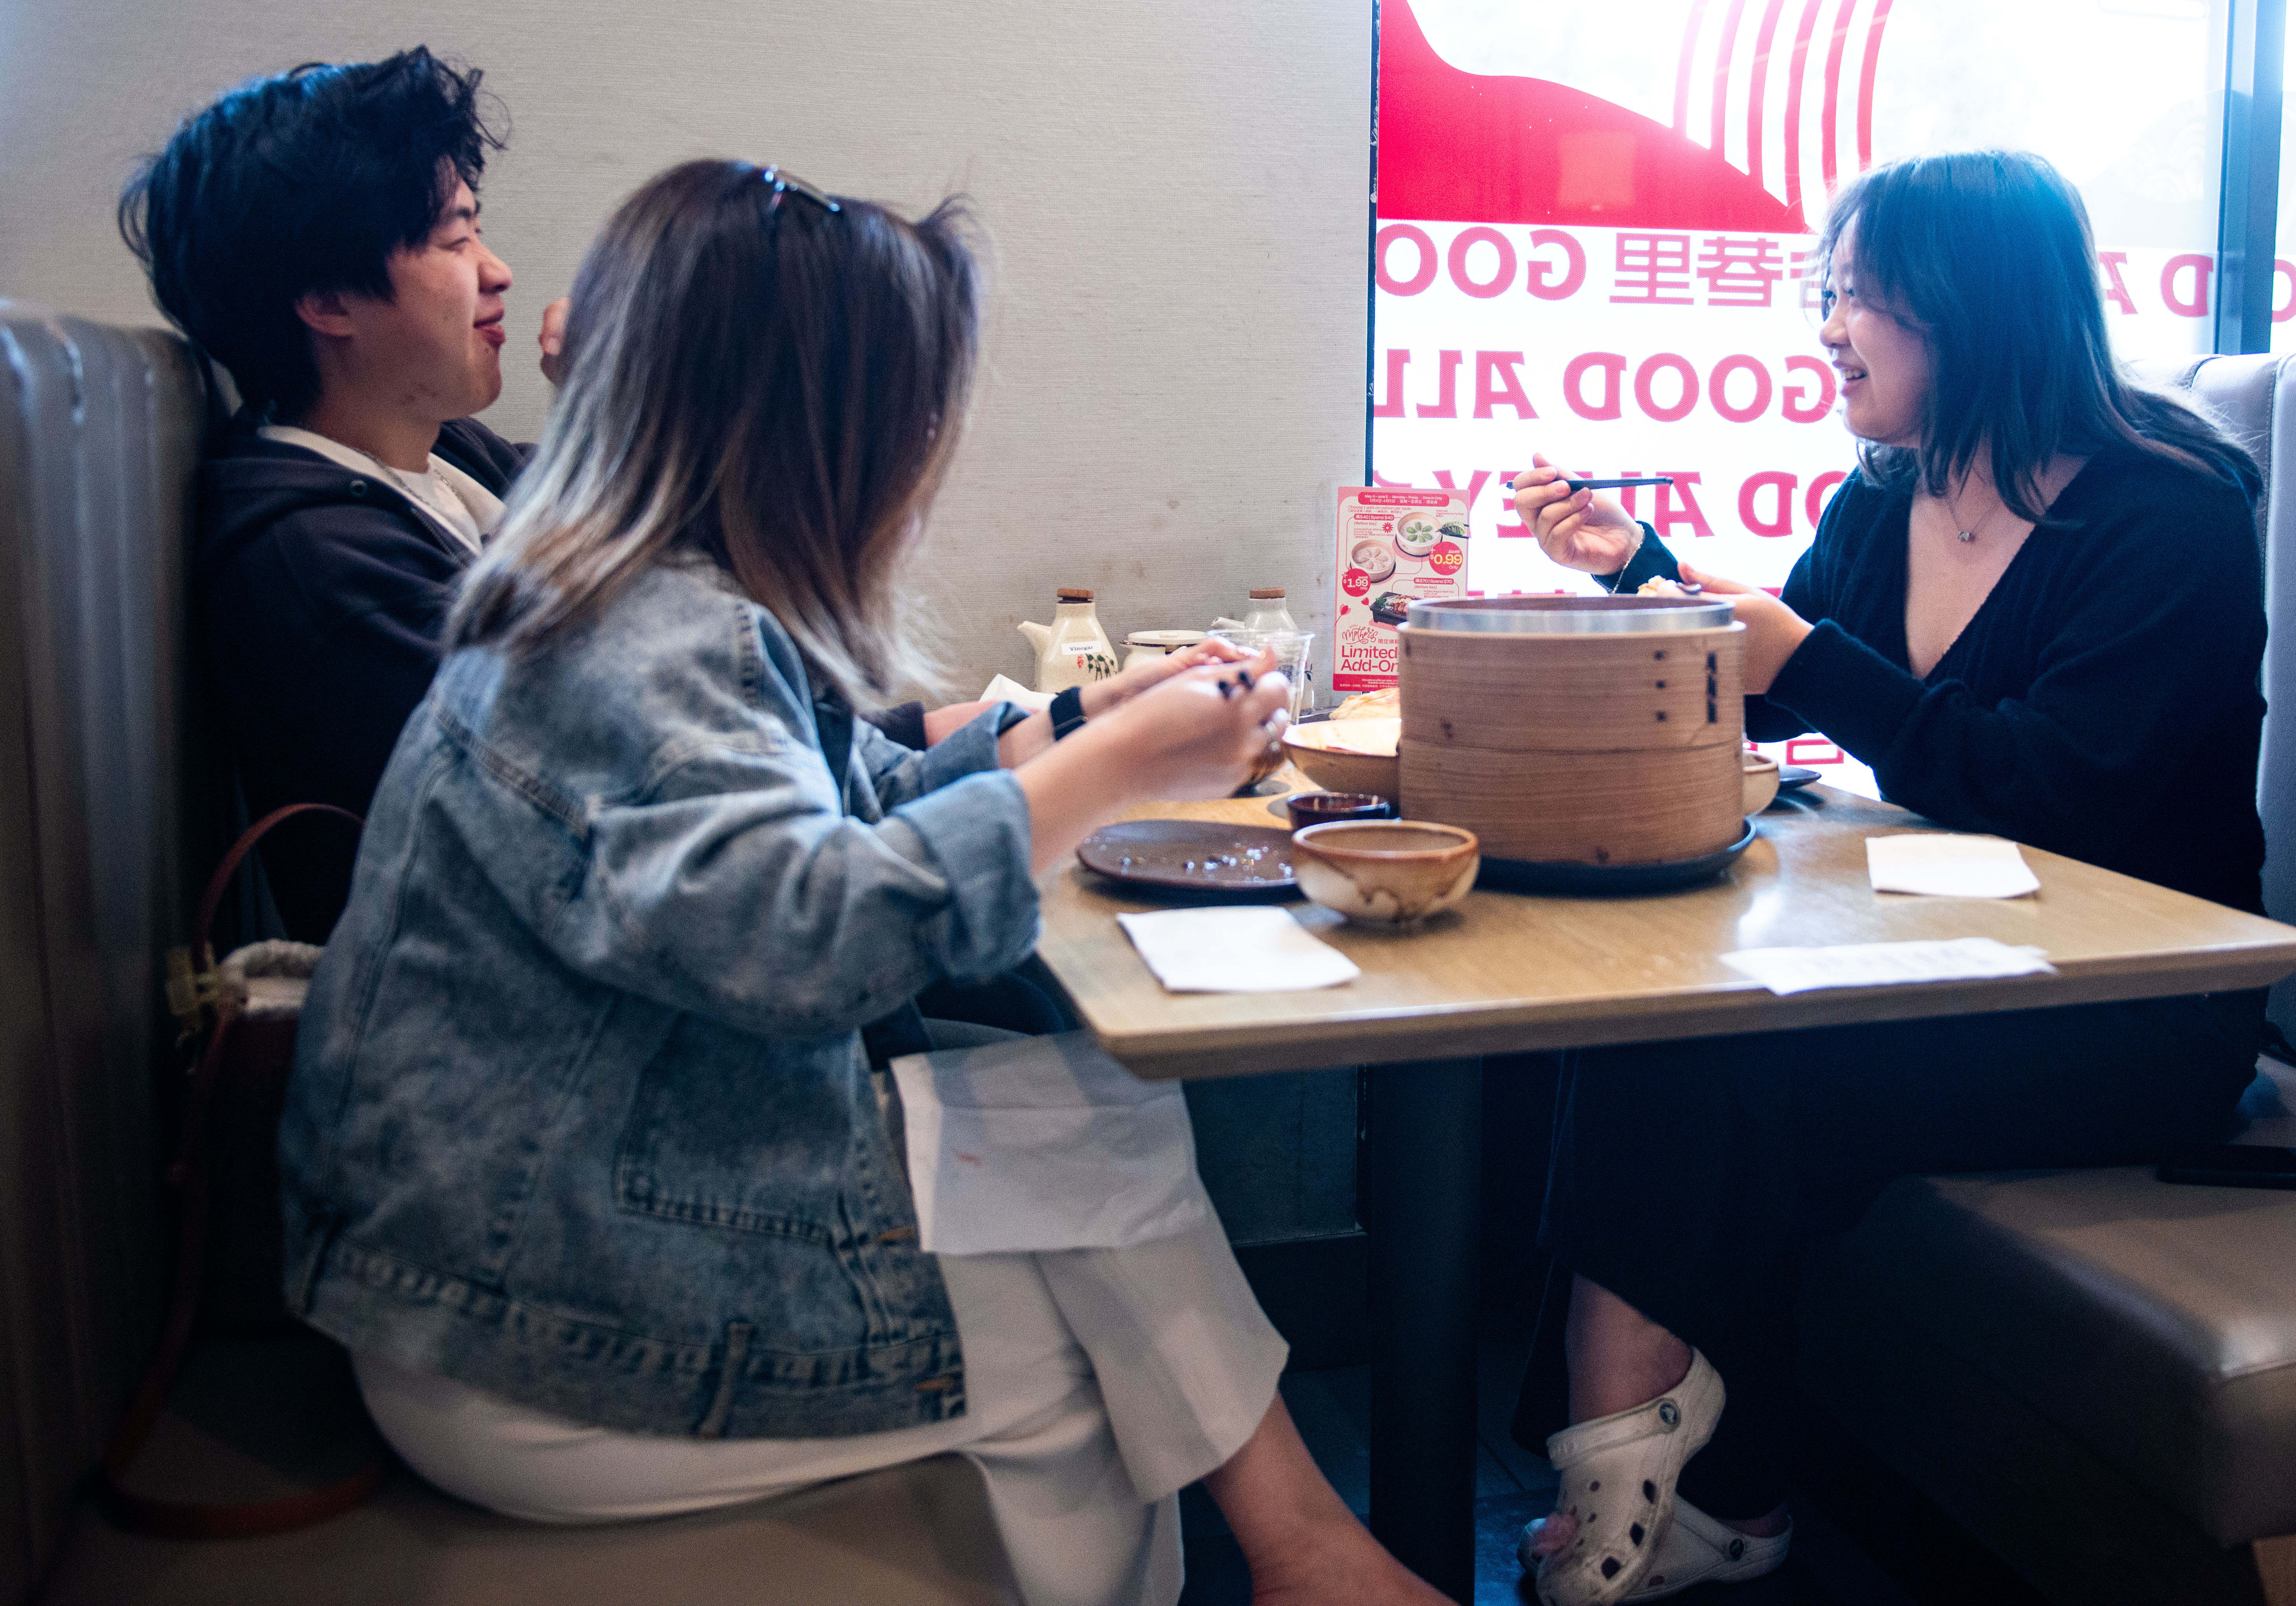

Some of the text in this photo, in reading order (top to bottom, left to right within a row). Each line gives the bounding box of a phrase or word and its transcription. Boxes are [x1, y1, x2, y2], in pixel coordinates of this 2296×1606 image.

[1430, 554, 1463, 565] $0.99
[1343, 579, 1368, 587] $1.99
[1342, 646, 1398, 659] Limited
